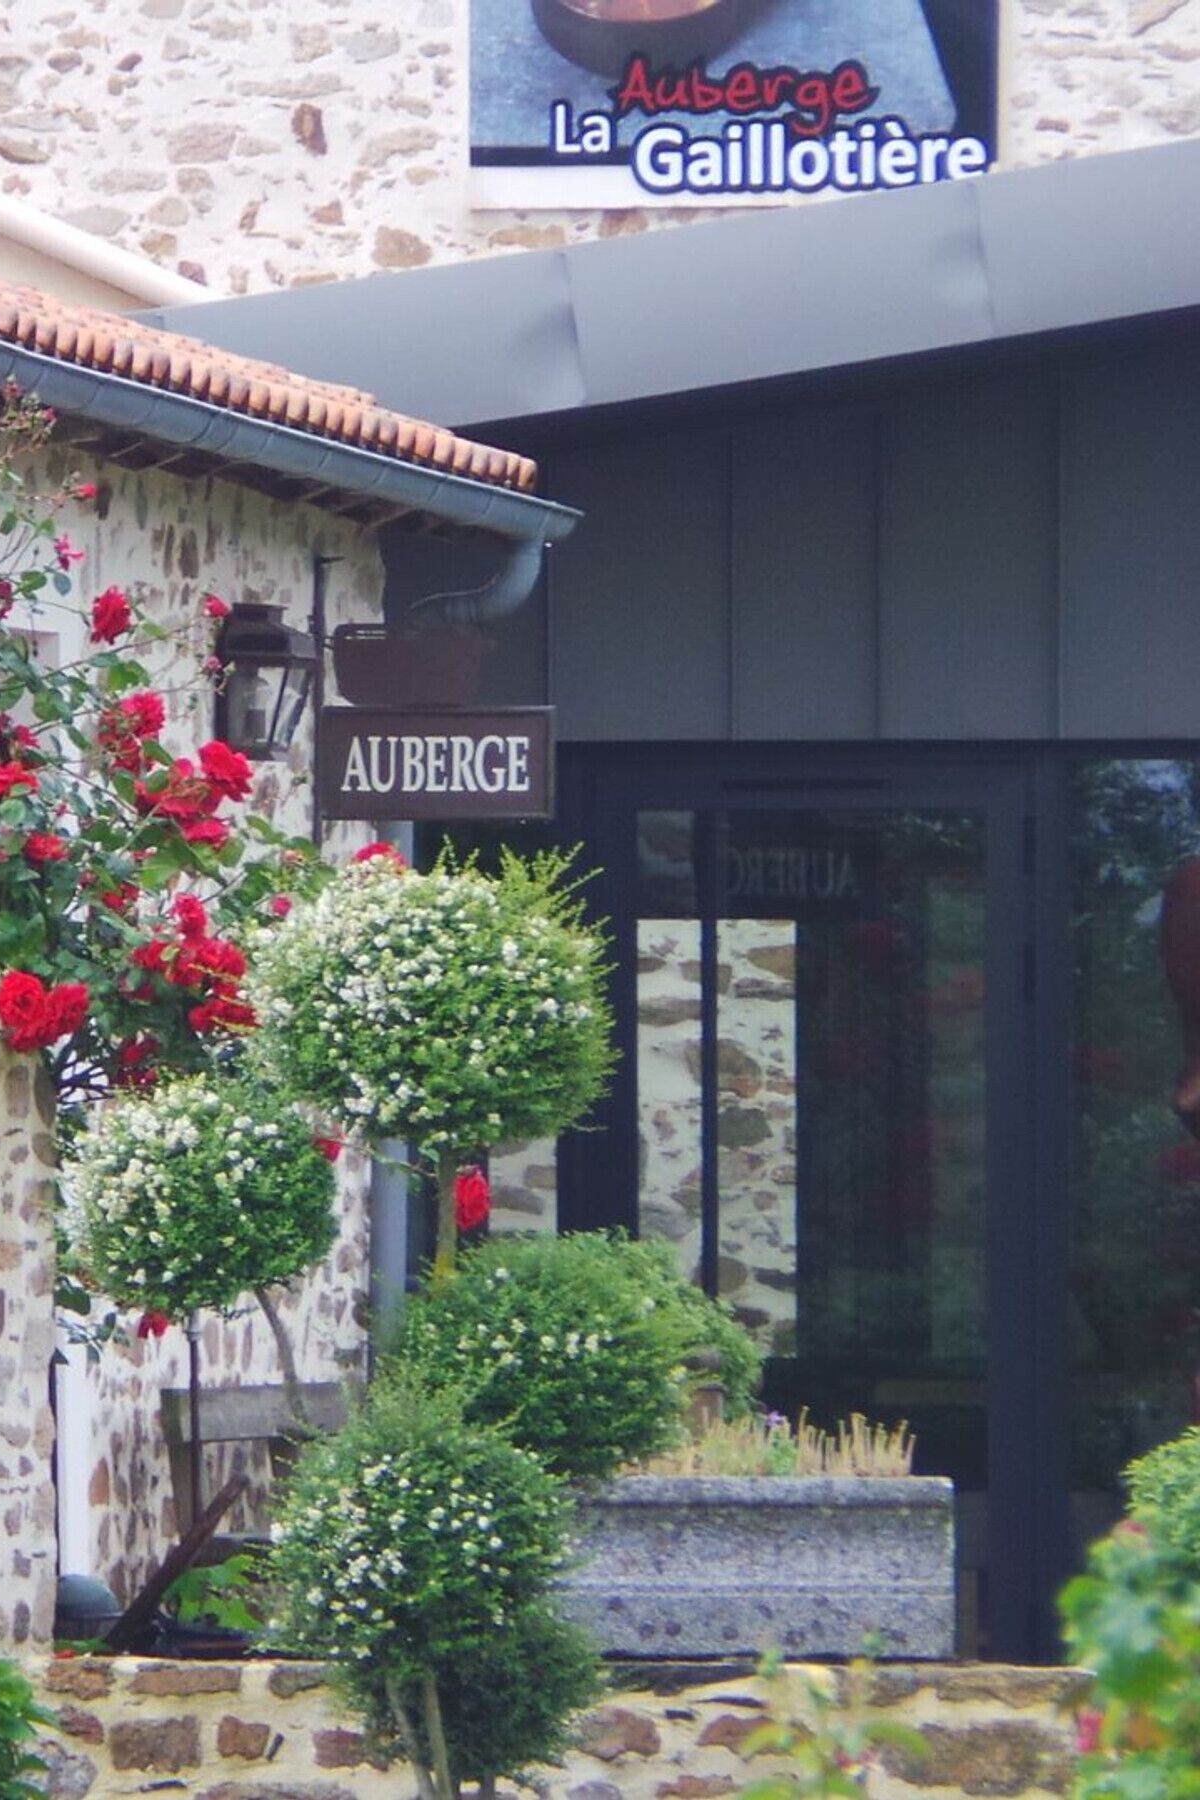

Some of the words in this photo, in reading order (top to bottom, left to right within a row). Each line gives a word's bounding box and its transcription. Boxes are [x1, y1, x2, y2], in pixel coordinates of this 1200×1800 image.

[618, 57, 870, 134] Auberge
[555, 103, 611, 153] La
[635, 121, 987, 187] Gaillotière
[341, 735, 530, 793] AUBERGE
